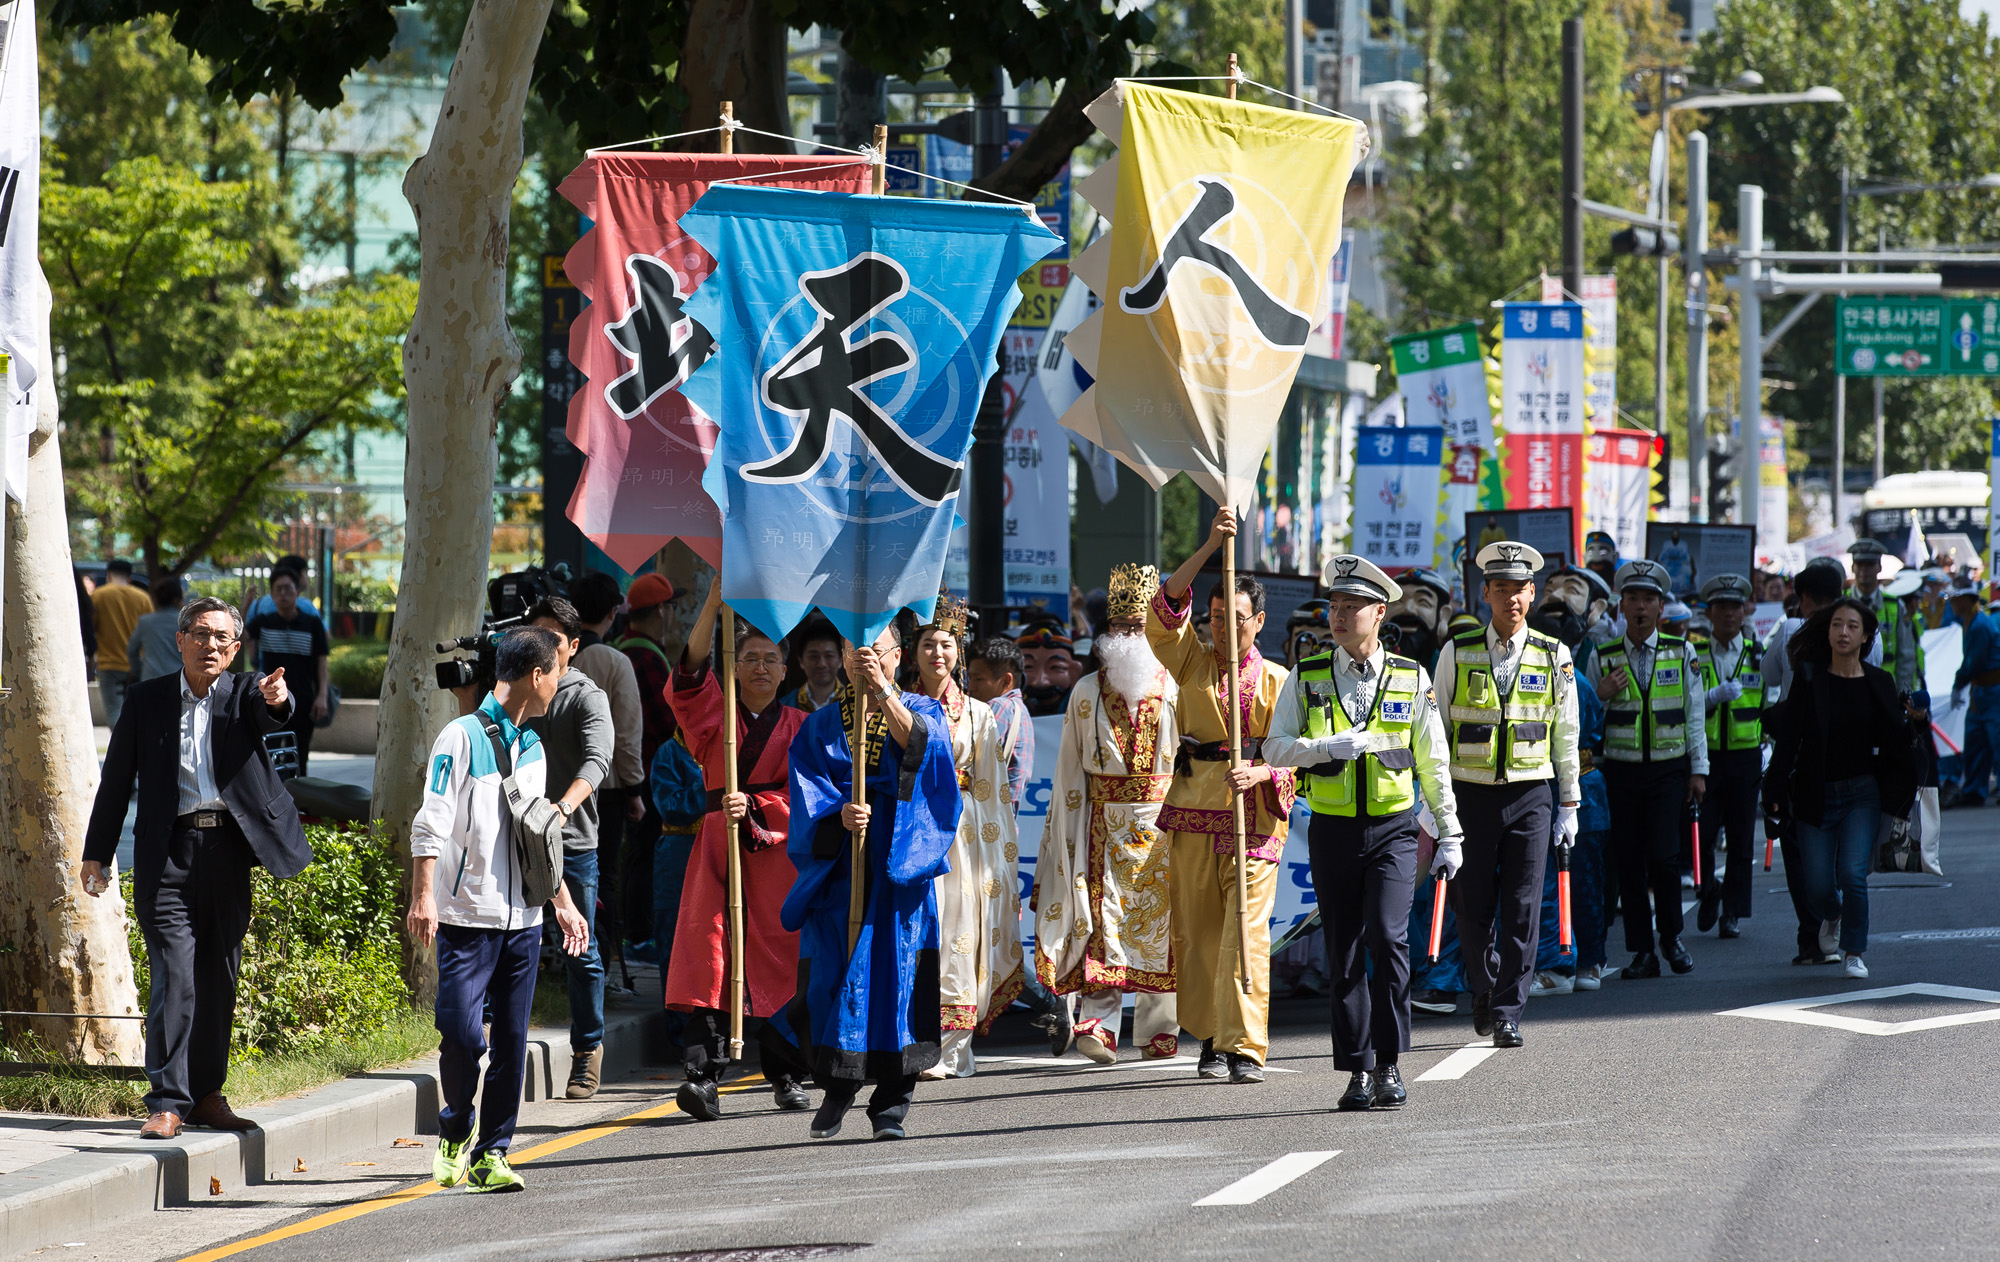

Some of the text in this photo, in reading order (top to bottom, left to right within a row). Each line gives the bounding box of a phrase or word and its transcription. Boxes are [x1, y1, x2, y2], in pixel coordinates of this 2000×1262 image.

[1120, 179, 1309, 346] 人
[1384, 702, 1410, 714] 경찰
[1384, 713, 1409, 721] POLICE
